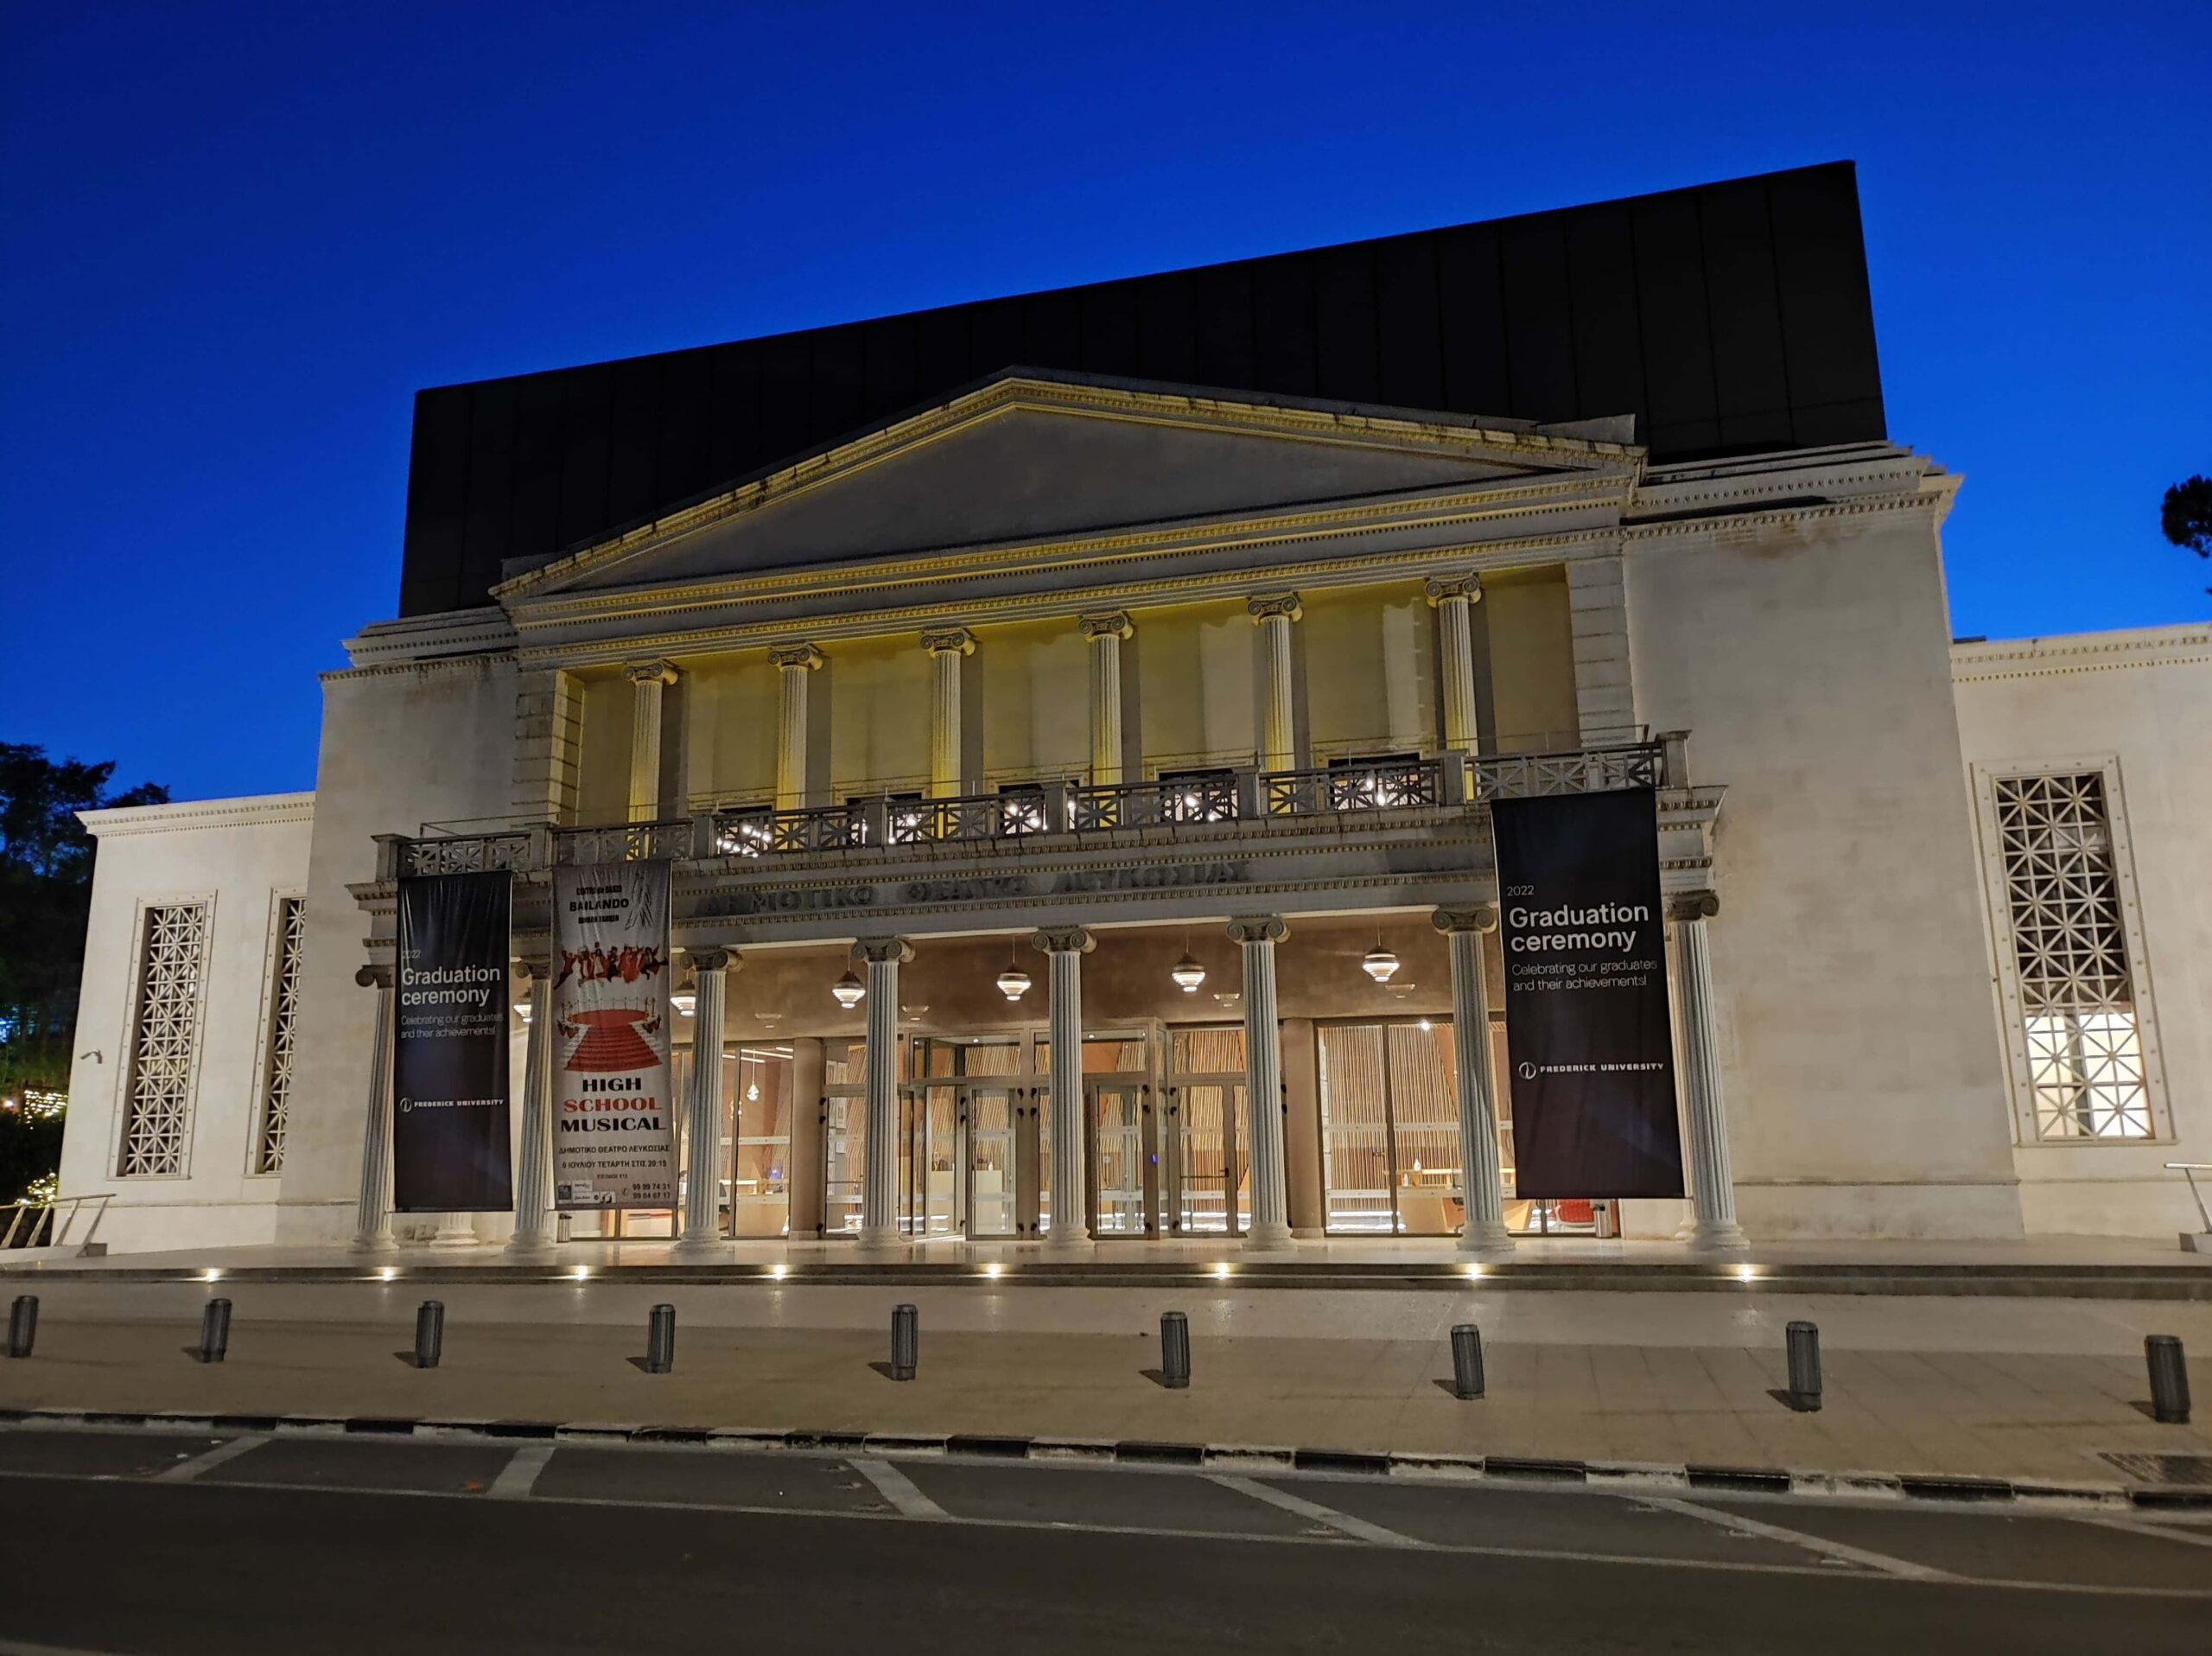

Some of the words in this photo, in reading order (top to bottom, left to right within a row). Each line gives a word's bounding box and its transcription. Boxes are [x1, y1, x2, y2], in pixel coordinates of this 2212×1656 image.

[1507, 885, 1535, 896] 2022
[569, 898, 629, 912] BAILANDO
[1510, 901, 1649, 928] Graduation
[1511, 930, 1637, 952] ceremony
[402, 949, 421, 959] 2022
[1512, 962, 1575, 976] Celebrating
[1579, 961, 1598, 972] our
[1600, 959, 1657, 975] graduates
[402, 965, 500, 986] Graduation
[1513, 978, 1535, 991] and
[1538, 978, 1563, 990] their
[1566, 974, 1647, 990] achievements!
[401, 988, 490, 1007] ceremony
[401, 1015, 443, 1026] Celebrating
[445, 1015, 460, 1024] our
[461, 1013, 504, 1026] graduates
[401, 1029, 415, 1039] and
[416, 1029, 433, 1038] their
[435, 1027, 496, 1037] achievements!
[1540, 1064, 1597, 1073] FREDERICK
[1600, 1062, 1664, 1071] UNIVERSITY
[582, 1077, 642, 1092] HIGH
[456, 1099, 504, 1107] UNIVERSITY
[563, 1097, 664, 1113] SCHOOL
[561, 1117, 667, 1133] MUSICAL
[559, 1146, 596, 1155] ΔΗΜΟΤΙΚΟ
[598, 1145, 627, 1154] ΘΕΑΤΡΟ
[629, 1144, 670, 1153] ΛΕΥΚΩΣΙΑΣ
